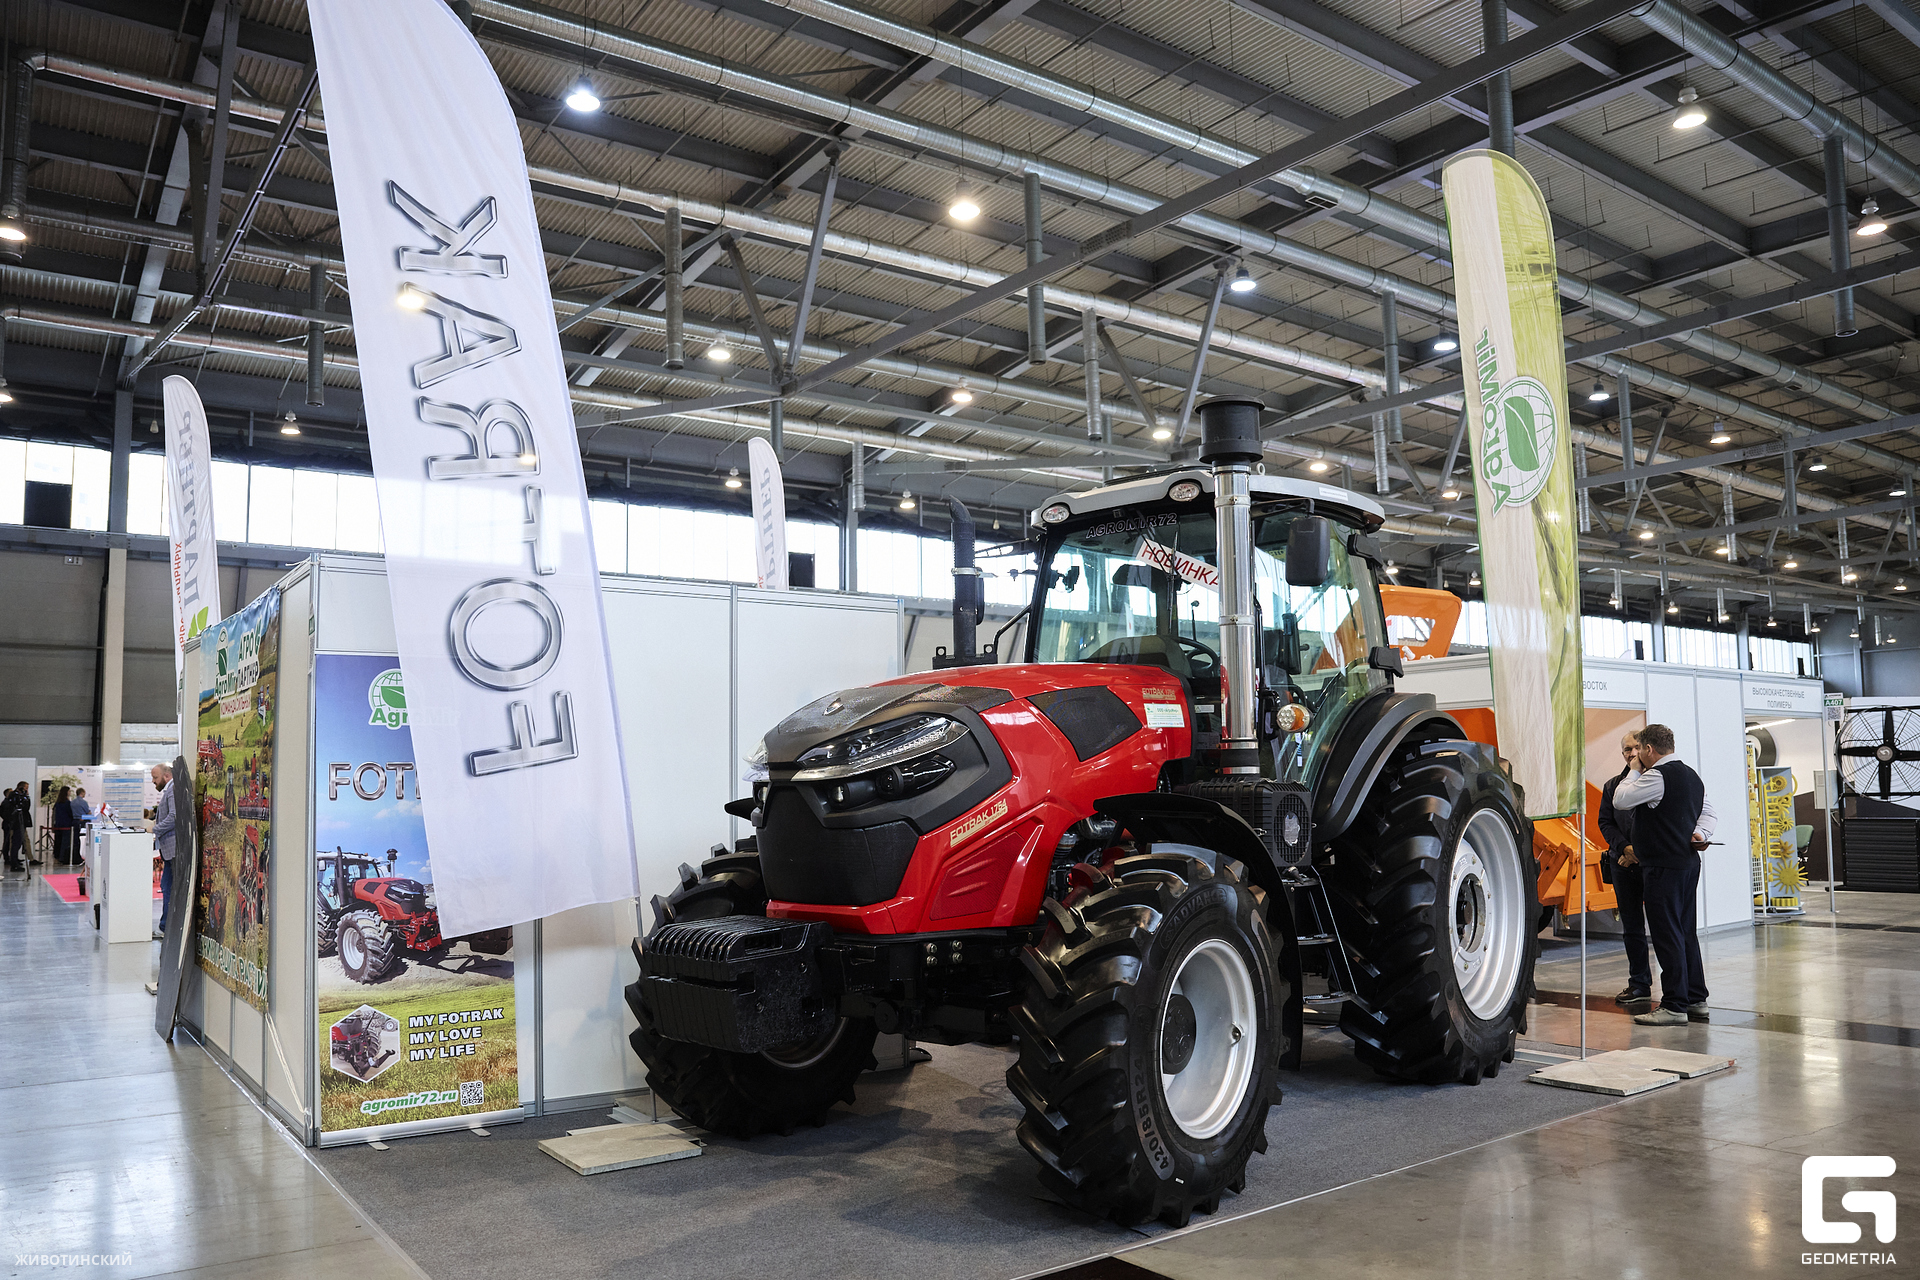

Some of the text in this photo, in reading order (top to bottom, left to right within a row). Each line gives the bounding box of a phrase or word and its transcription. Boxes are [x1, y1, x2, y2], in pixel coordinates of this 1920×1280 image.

[328, 761, 422, 801] FOT
[950, 808, 989, 841] FOTRAK
[409, 1008, 504, 1028] MY FOTRAK
[409, 1026, 482, 1045] MY LOVE
[410, 1043, 475, 1062] MY LIFE
[362, 1091, 457, 1113] agromir72.ru
